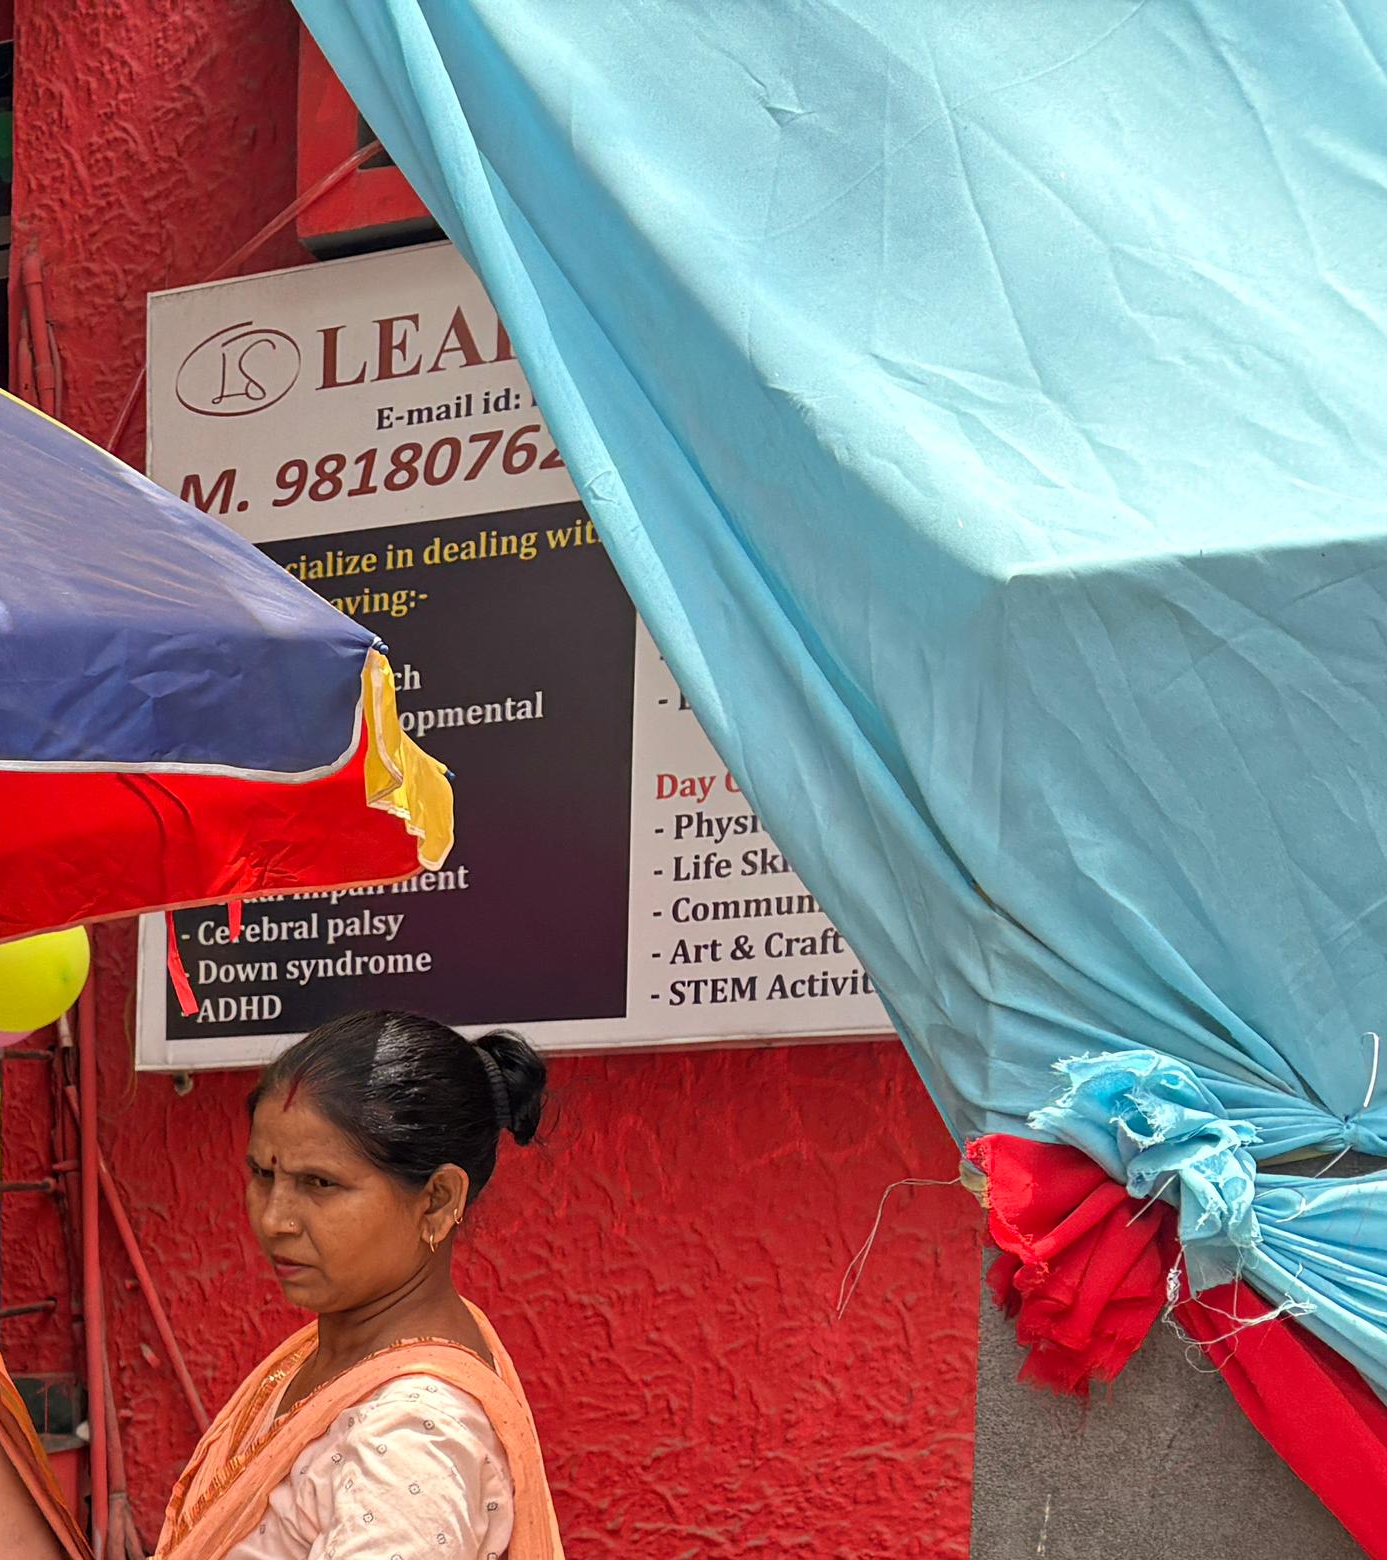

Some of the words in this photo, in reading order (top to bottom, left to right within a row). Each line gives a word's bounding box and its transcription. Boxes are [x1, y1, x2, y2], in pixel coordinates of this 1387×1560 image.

[376, 397, 473, 430] E-mail
[483, 388, 521, 414] id:
[180, 468, 250, 515] M.
[286, 549, 378, 580] cialize
[386, 544, 414, 570] in
[423, 530, 539, 567] dealing
[547, 519, 602, 550] wit
[329, 588, 428, 619] aving:-
[400, 691, 545, 738] opmental
[655, 773, 716, 803] Day
[673, 811, 761, 843] Physi
[672, 853, 732, 882] Life
[671, 892, 826, 924] Commun
[197, 912, 319, 945] Cerebral
[327, 909, 405, 941] palsy
[669, 938, 723, 965] Art
[729, 934, 756, 961] &
[764, 927, 845, 959] Craft
[197, 957, 278, 986] Down
[285, 950, 433, 988] syndrome
[669, 975, 759, 1007] STEM
[766, 969, 879, 1001] Activit
[196, 994, 283, 1023] ADHD
